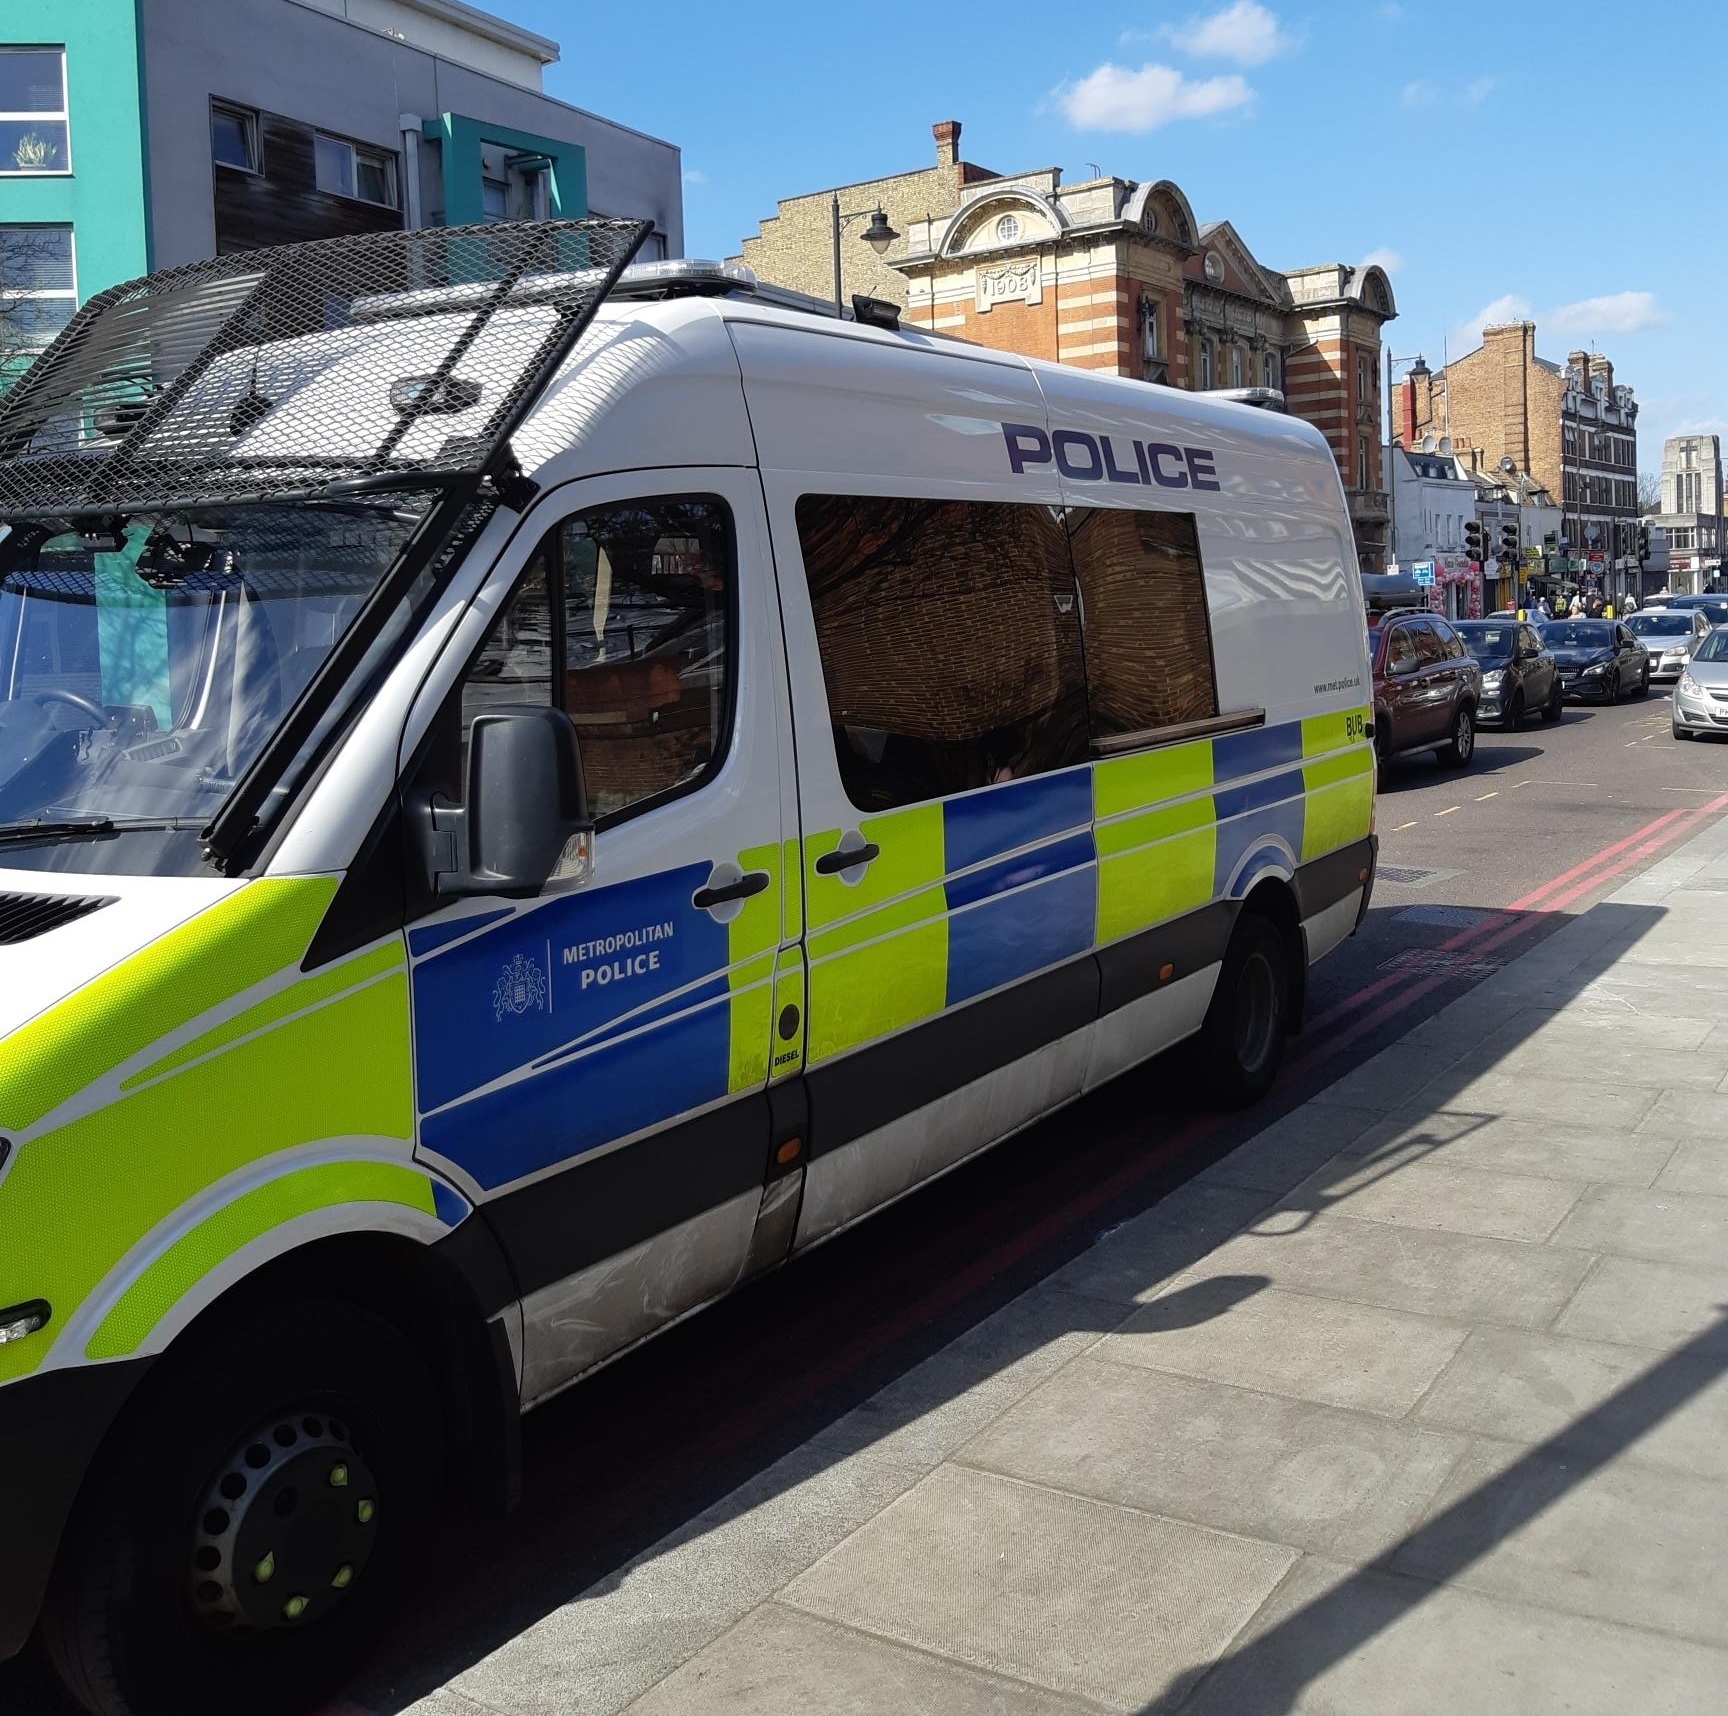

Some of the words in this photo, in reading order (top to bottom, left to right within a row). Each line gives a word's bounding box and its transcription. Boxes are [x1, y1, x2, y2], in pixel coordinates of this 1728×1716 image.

[991, 278, 1028, 296] 1908
[1001, 422, 1221, 492] POLICE
[1346, 714, 1363, 737] BUB
[563, 921, 674, 965] METROPOLITAN
[581, 950, 660, 989] POLICE
[774, 1048, 800, 1067] DIESEL
